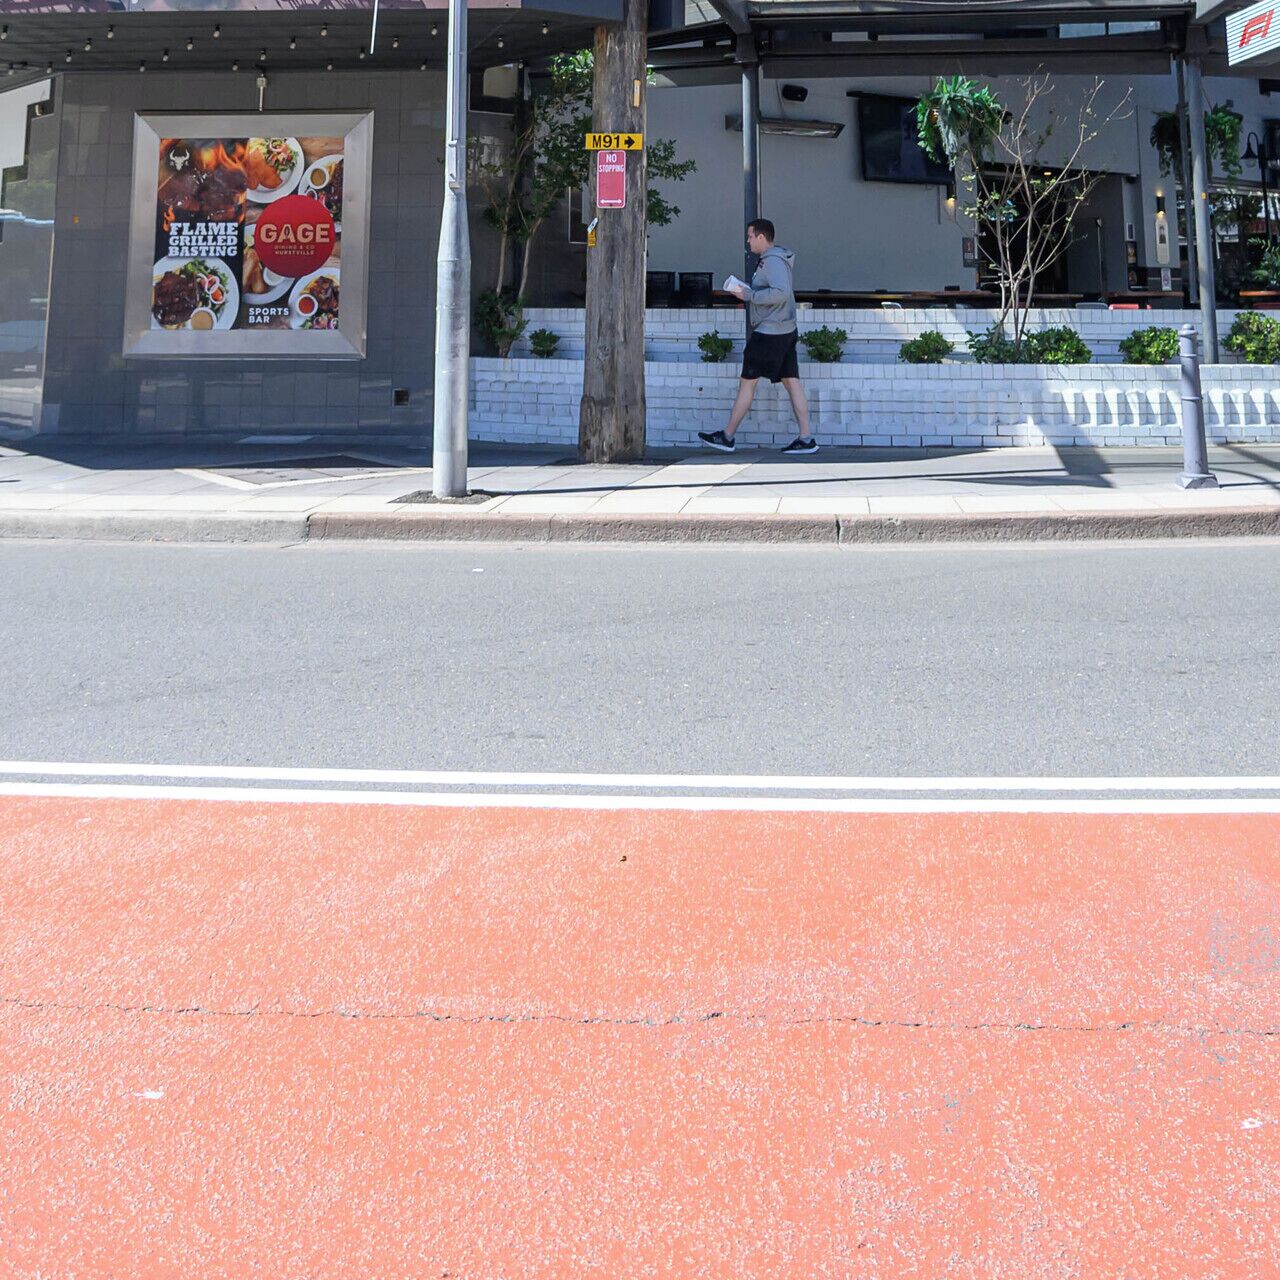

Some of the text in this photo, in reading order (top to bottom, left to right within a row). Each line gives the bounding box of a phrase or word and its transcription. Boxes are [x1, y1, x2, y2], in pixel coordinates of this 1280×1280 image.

[592, 134, 620, 149] M91
[605, 153, 618, 163] NO
[599, 164, 625, 173] STOPPING
[169, 222, 239, 236] FLAME
[260, 223, 331, 243] GAGE
[169, 235, 238, 246] GRILLED
[168, 246, 238, 257] BASTING
[248, 307, 290, 316] SPORTS
[248, 315, 271, 324] BAR
